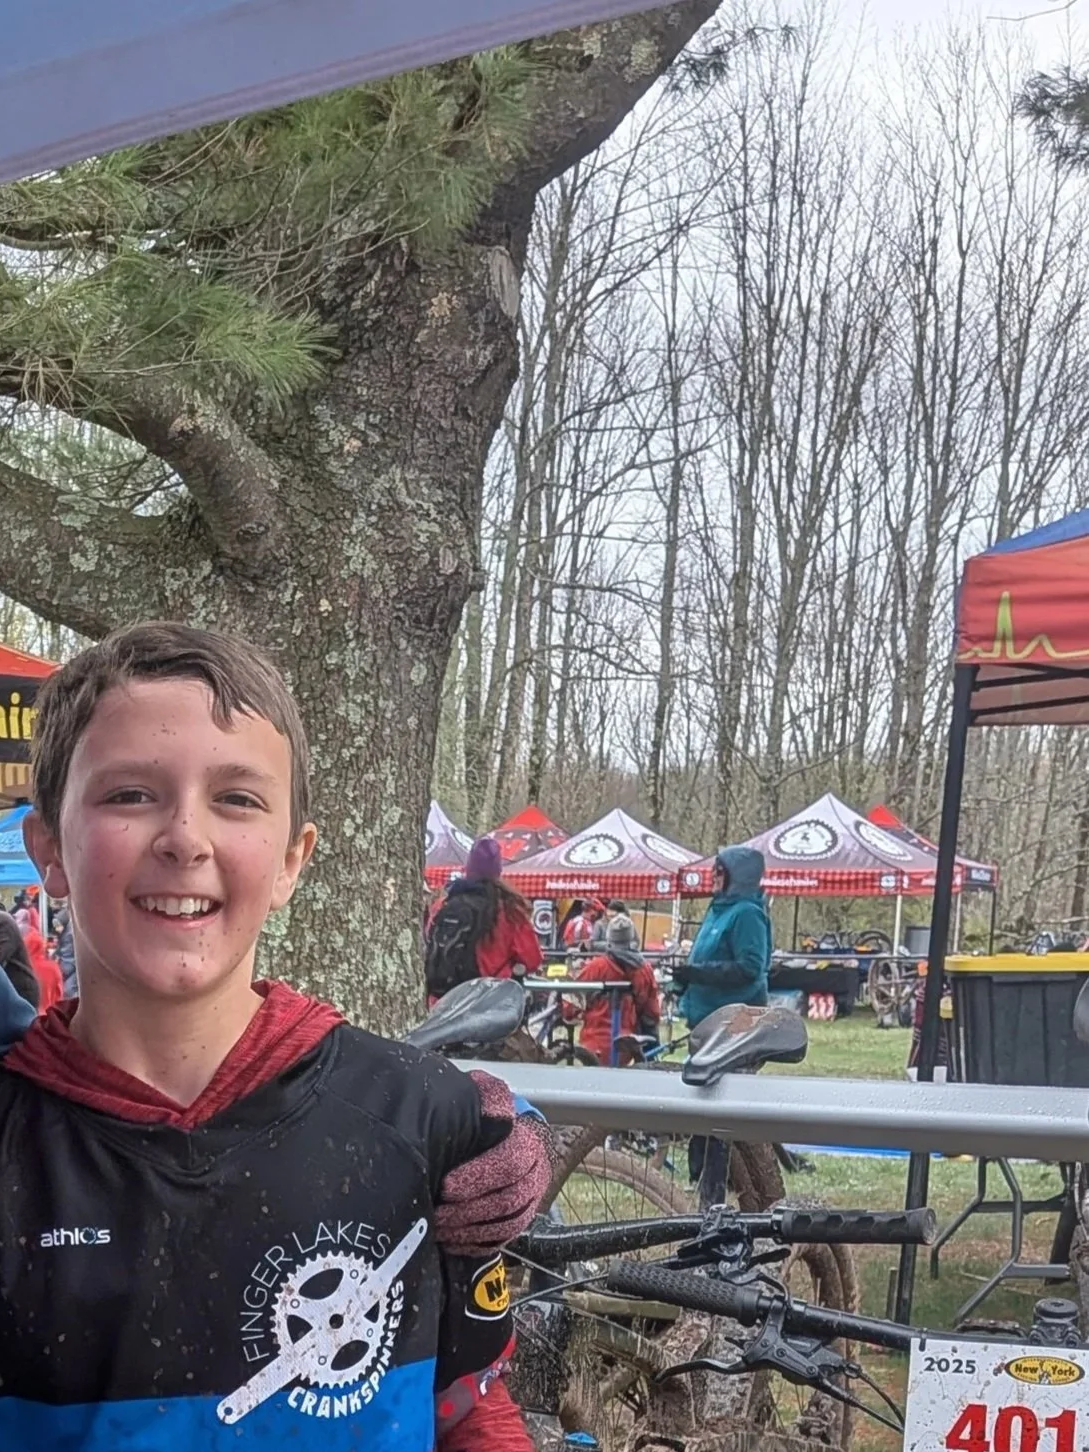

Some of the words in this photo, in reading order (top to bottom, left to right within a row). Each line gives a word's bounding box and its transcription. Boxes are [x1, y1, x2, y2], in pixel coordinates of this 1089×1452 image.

[40, 1227, 111, 1247] athlos
[240, 1245, 293, 1362] FINGER
[292, 1220, 391, 1258] LAKES
[287, 1279, 404, 1419] CRANKSPINNERS
[924, 1357, 976, 1374] 2025
[1015, 1363, 1039, 1374] New
[1051, 1364, 1076, 1377] York
